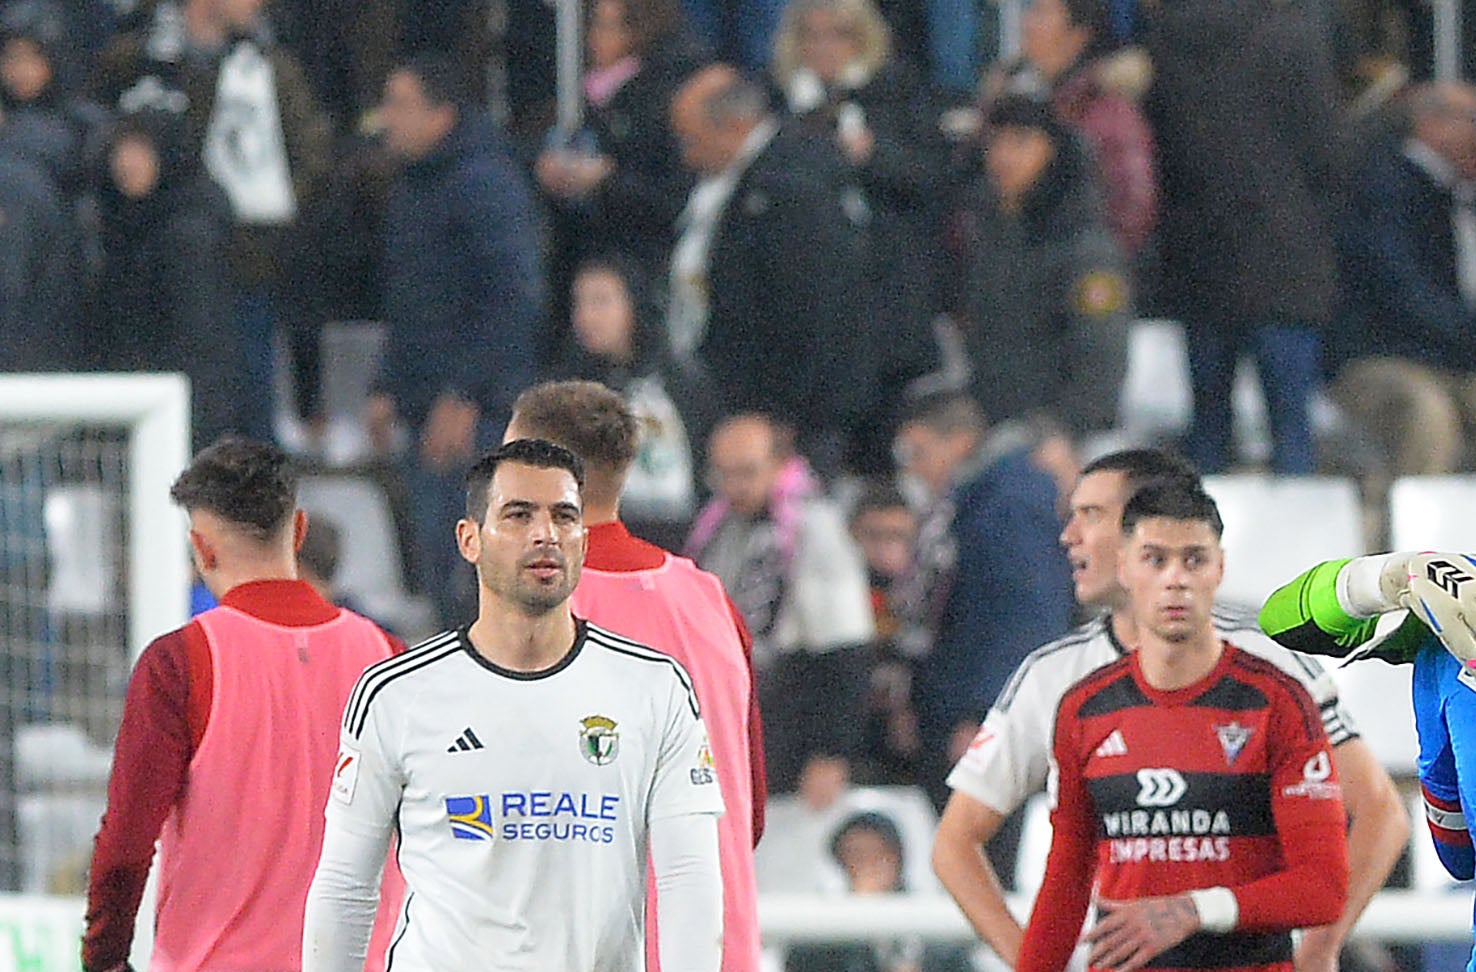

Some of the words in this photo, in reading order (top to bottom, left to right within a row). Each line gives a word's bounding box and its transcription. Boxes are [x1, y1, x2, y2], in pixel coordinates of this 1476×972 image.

[502, 792, 619, 820] REALE
[503, 824, 614, 844] SEGUROS
[1103, 809, 1231, 836] MIRANDA
[1110, 836, 1231, 863] EMPRESAS
